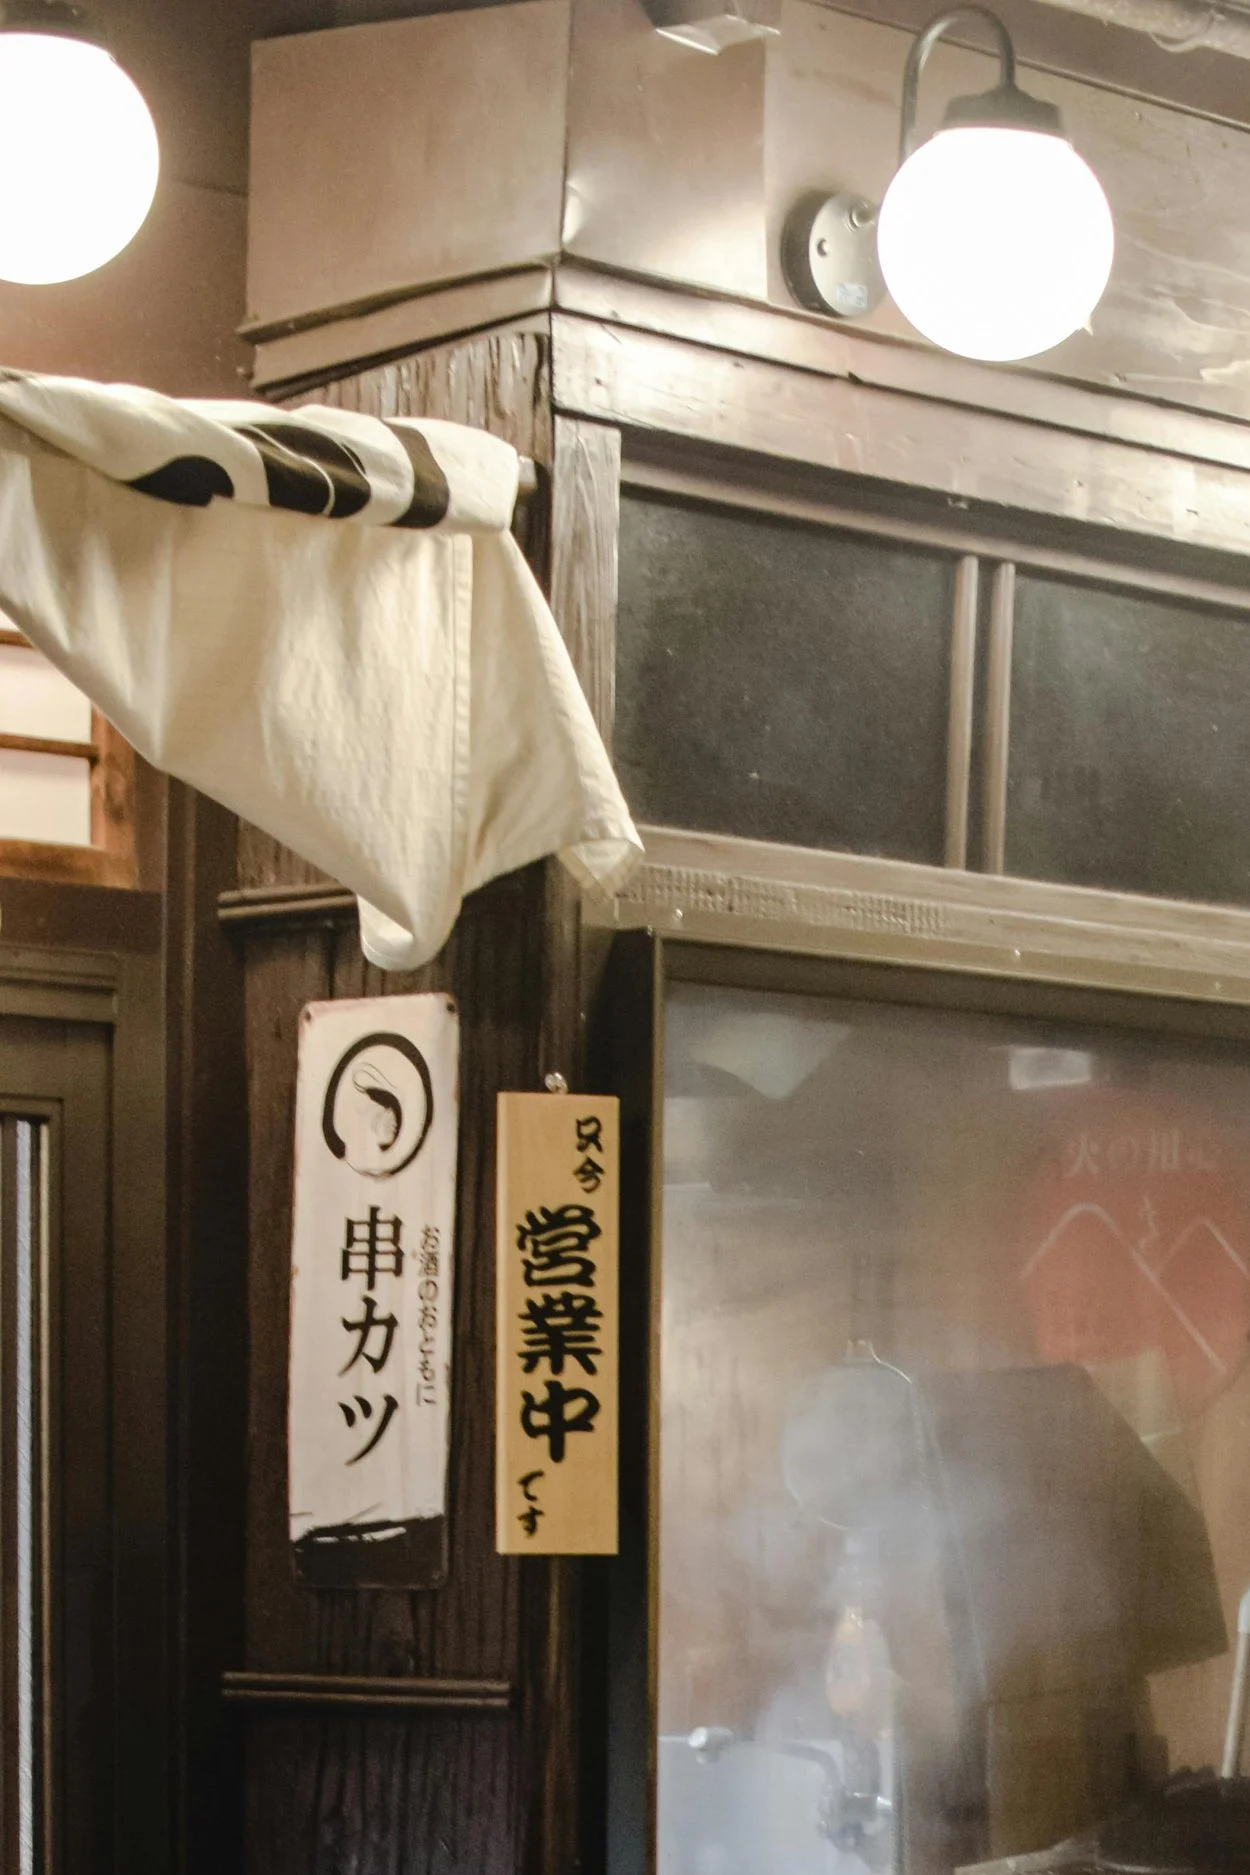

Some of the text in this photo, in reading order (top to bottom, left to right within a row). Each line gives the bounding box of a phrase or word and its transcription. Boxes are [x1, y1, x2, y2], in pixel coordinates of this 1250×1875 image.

[573, 1115, 604, 1194] 只今
[339, 1206, 405, 1466] 串カツ
[516, 1204, 602, 1463] 営業中
